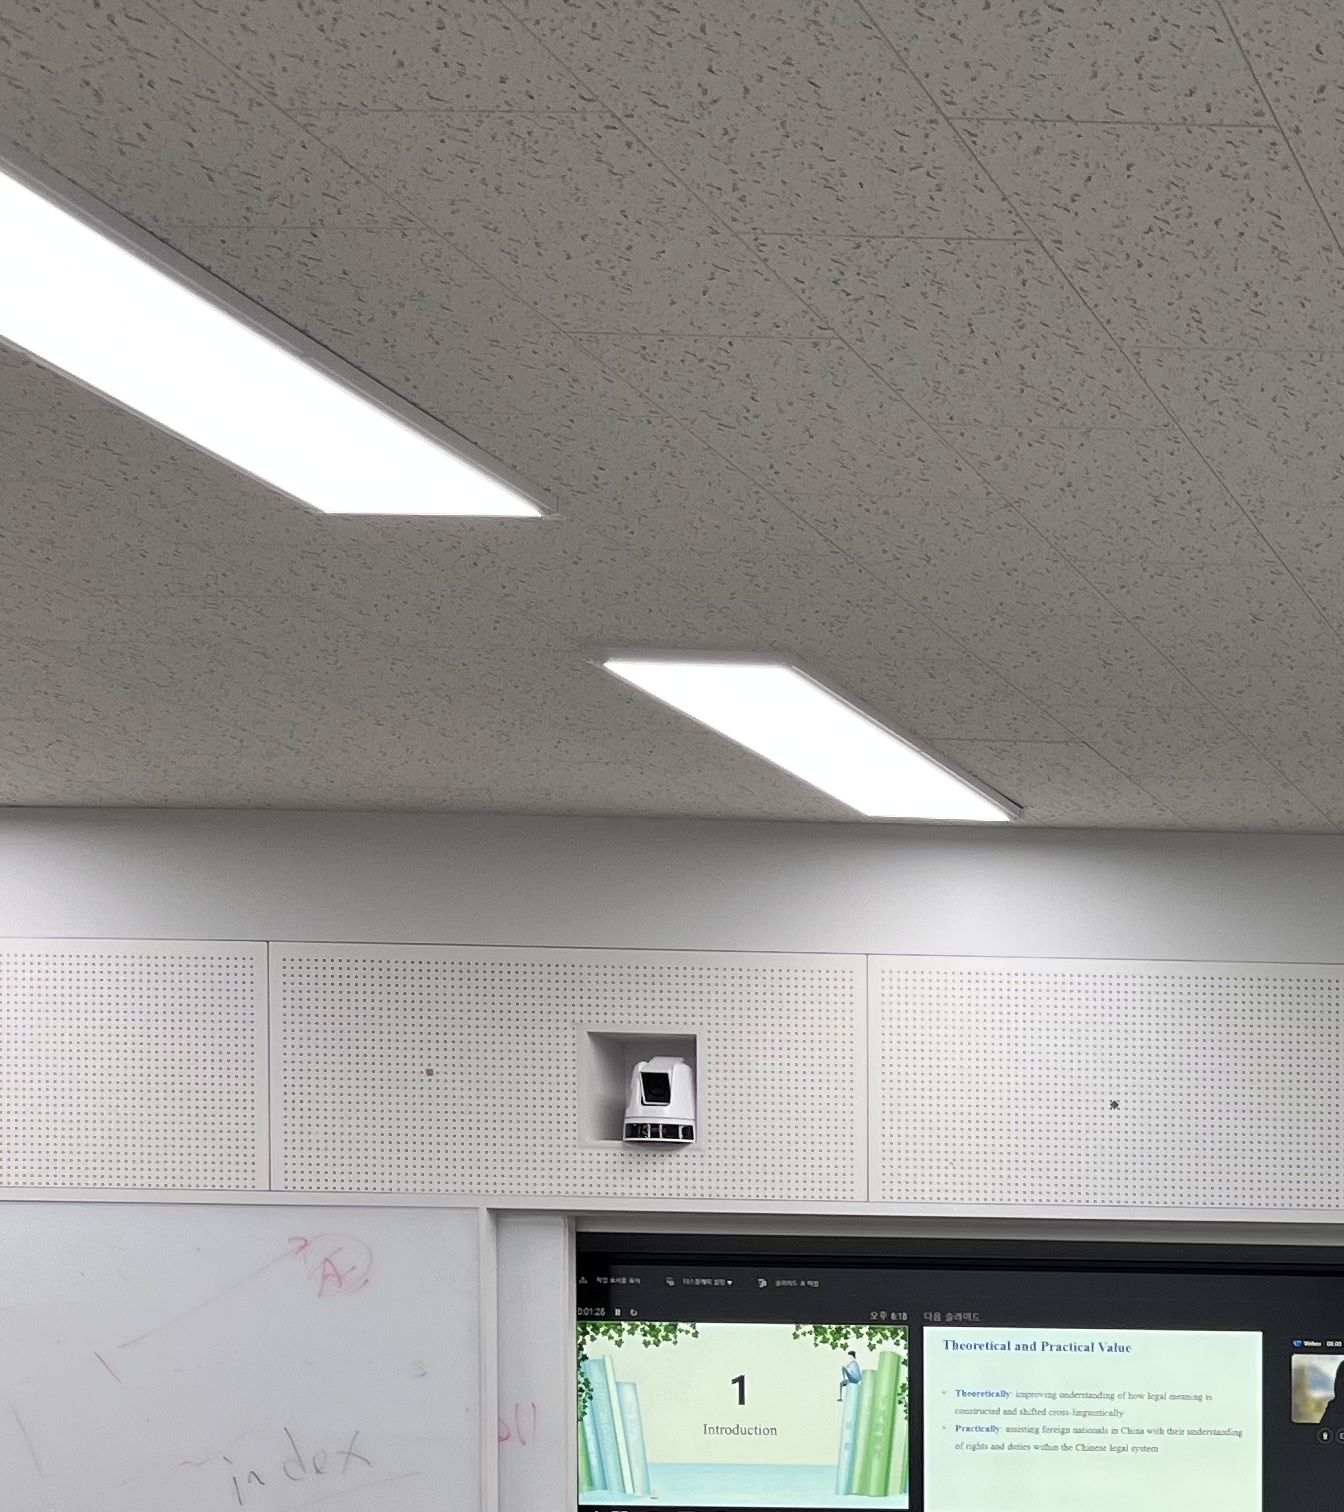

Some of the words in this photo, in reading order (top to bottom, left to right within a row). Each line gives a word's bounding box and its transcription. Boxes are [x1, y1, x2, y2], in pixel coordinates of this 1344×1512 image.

[943, 1339, 1011, 1351] Theoretical
[1014, 1341, 1037, 1352] and
[1041, 1341, 1095, 1353] Practical
[1099, 1342, 1132, 1353] Value
[731, 1374, 746, 1406] 1
[703, 1423, 778, 1437] Introduction
[223, 1426, 371, 1505] index
